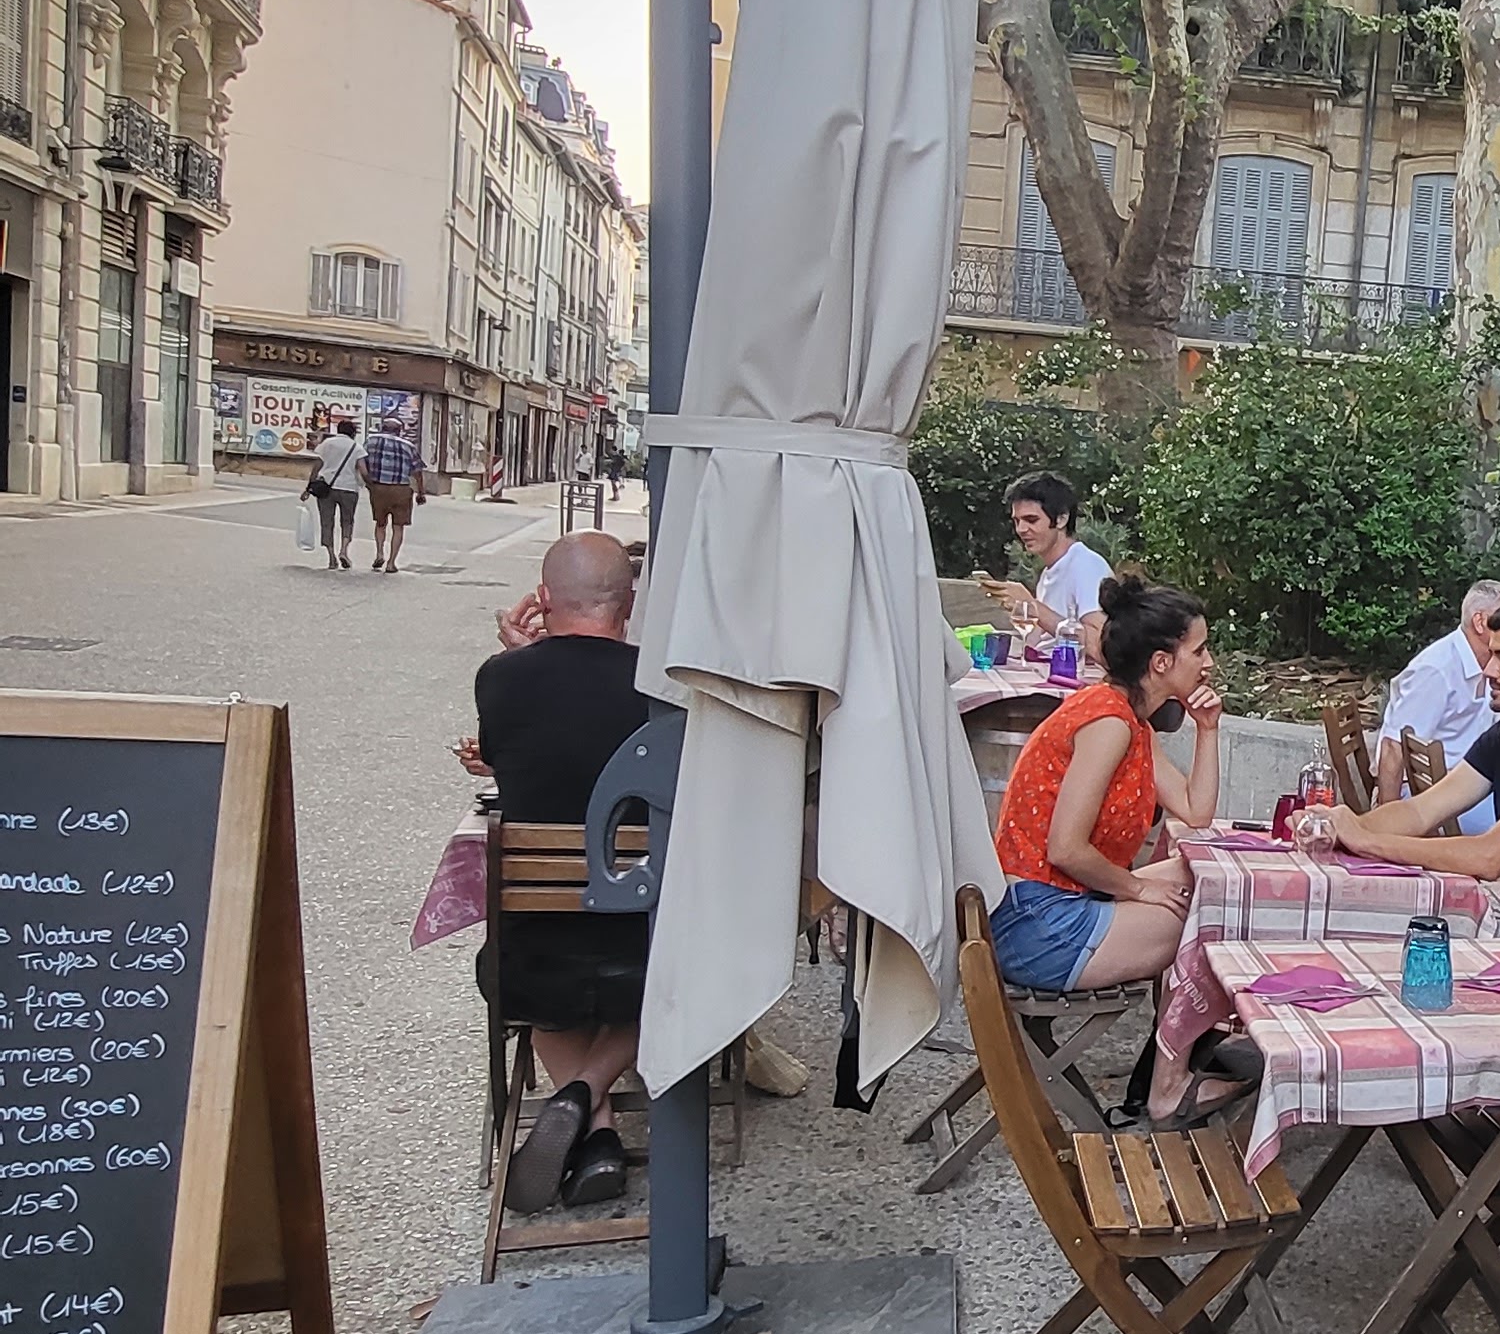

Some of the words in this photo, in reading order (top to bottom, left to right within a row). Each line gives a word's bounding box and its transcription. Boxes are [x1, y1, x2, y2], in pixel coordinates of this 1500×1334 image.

[253, 395, 305, 413] TOUT
[57, 807, 130, 836] (13€)
[101, 870, 174, 895] (12€)
[23, 922, 113, 945] Nature
[125, 921, 190, 947] (12€)
[18, 951, 99, 976] Truffes
[101, 984, 170, 1009] (20€)
[34, 1010, 105, 1031] (12€)
[0, 1046, 75, 1062] rmiers
[90, 1033, 166, 1062] (20€)
[23, 1064, 91, 1087] (12€)
[61, 1093, 140, 1119] (30€)
[17, 1118, 95, 1144] (18€)
[0, 1156, 96, 1179] rsonnes
[105, 1142, 171, 1170] (60€)
[0, 1184, 79, 1216] 15€)
[2, 1224, 95, 1259] (15€)
[40, 1286, 125, 1324] (14€)
